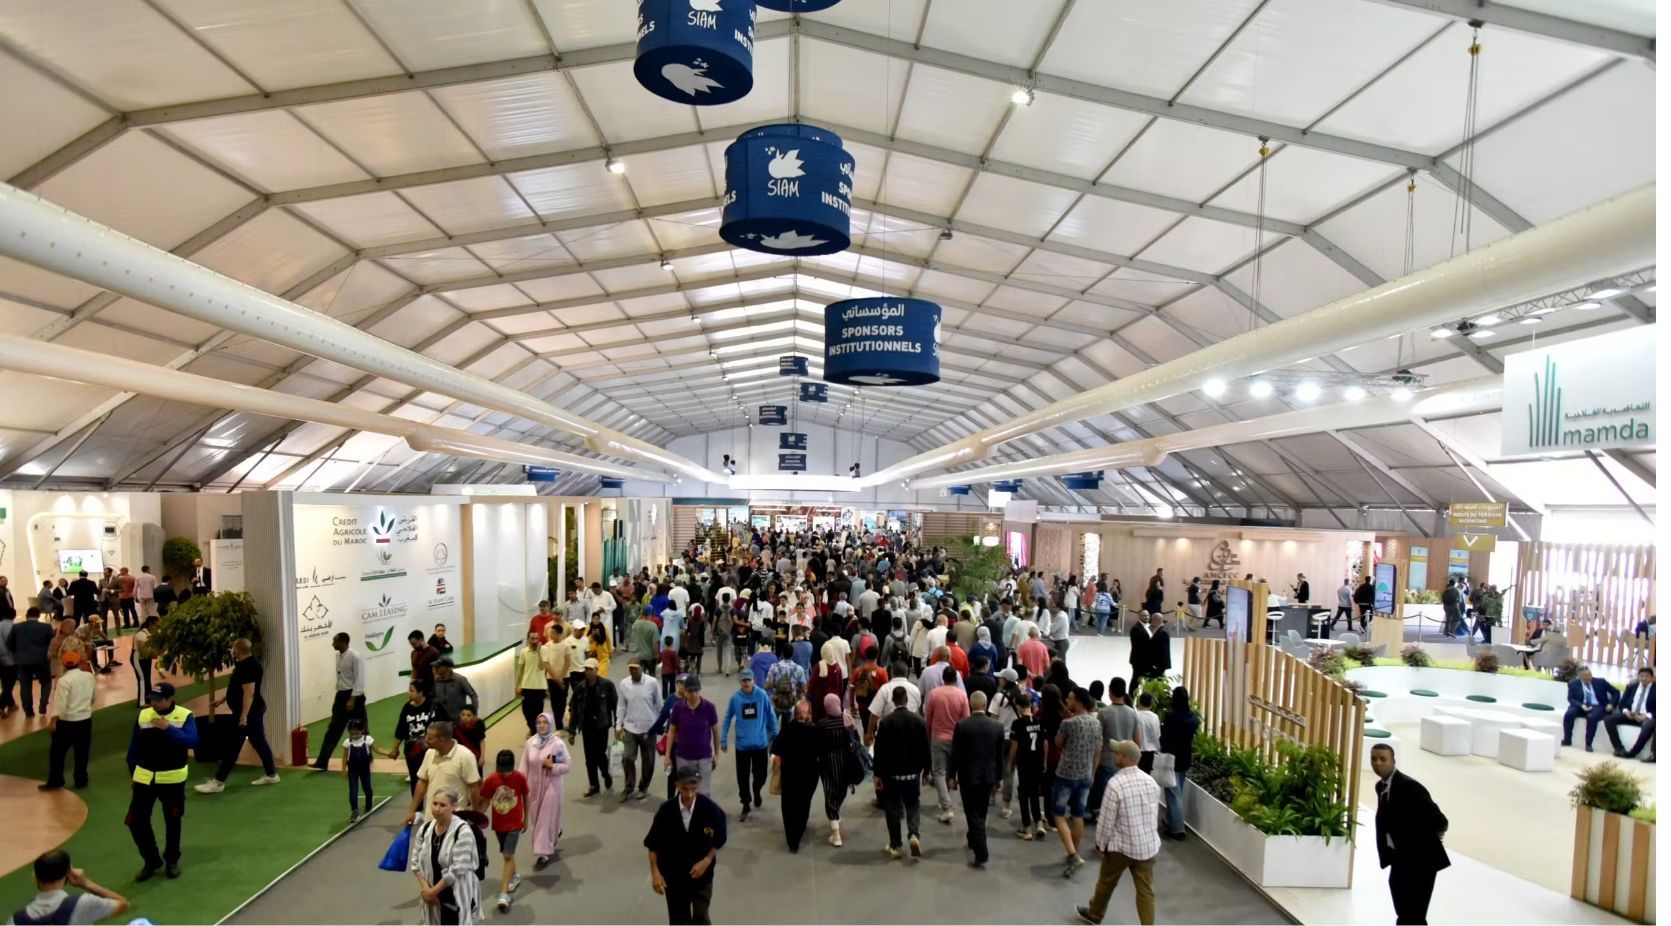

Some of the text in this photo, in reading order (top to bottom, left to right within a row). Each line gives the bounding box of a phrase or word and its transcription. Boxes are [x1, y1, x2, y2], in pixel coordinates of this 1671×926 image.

[687, 11, 717, 30] SIAM
[767, 179, 800, 198] SIAM
[842, 303, 905, 321] المؤسساتي
[841, 325, 904, 338] SPONSORS
[829, 341, 922, 357] INSTITUTIONNELS
[1563, 417, 1649, 445] mamda
[332, 516, 358, 526] CREDIT
[333, 527, 367, 536] AGRICOLE
[344, 537, 367, 545] MAROC
[361, 605, 408, 620] CAM LEASING
[1029, 732, 1038, 750] 7
